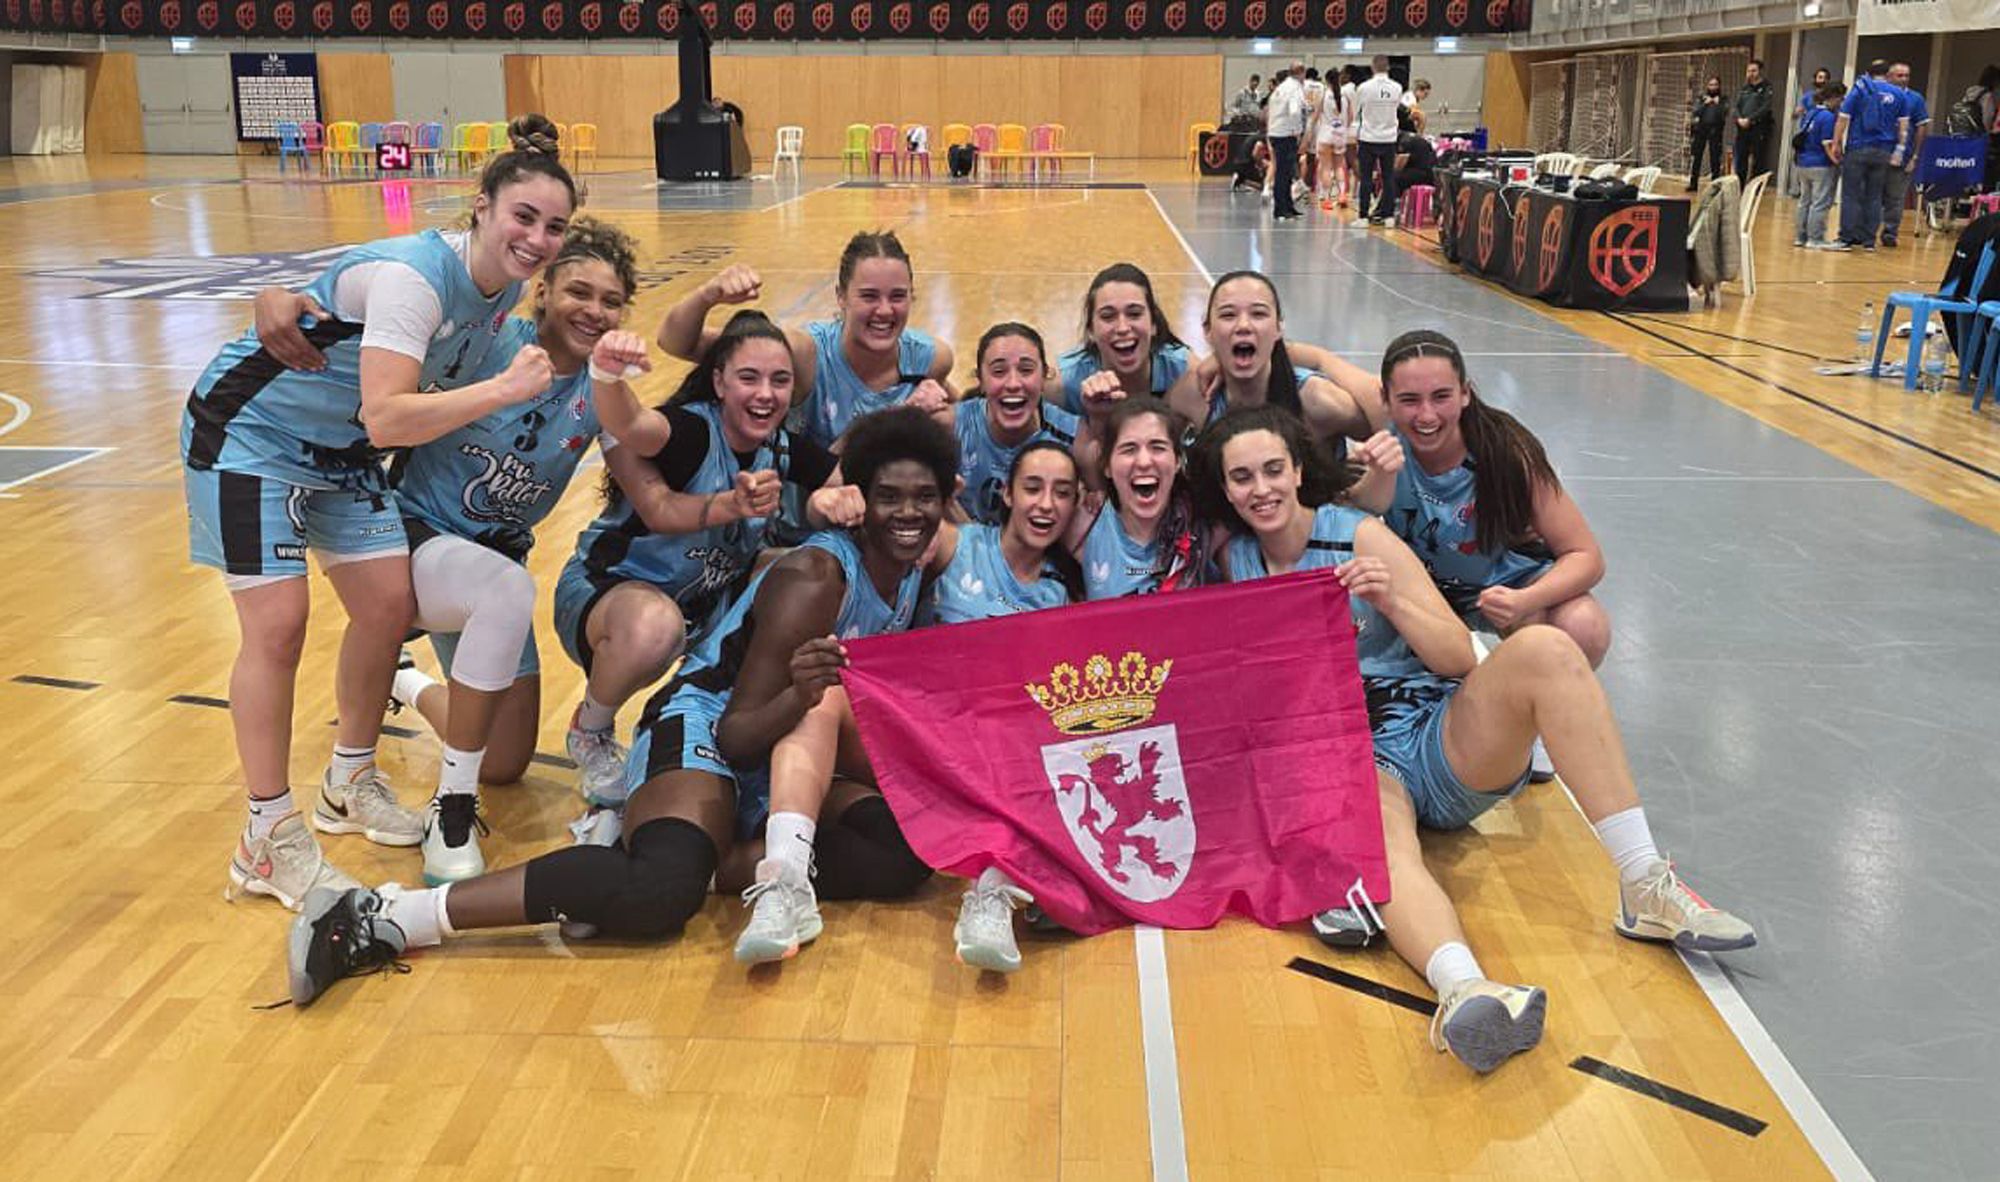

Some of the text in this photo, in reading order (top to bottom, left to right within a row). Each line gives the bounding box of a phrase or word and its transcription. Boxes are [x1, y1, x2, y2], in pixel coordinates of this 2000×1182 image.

[380, 145, 407, 168] 24
[1935, 156, 1976, 169] molten
[513, 410, 547, 452] 3
[1401, 507, 1440, 553] 14
